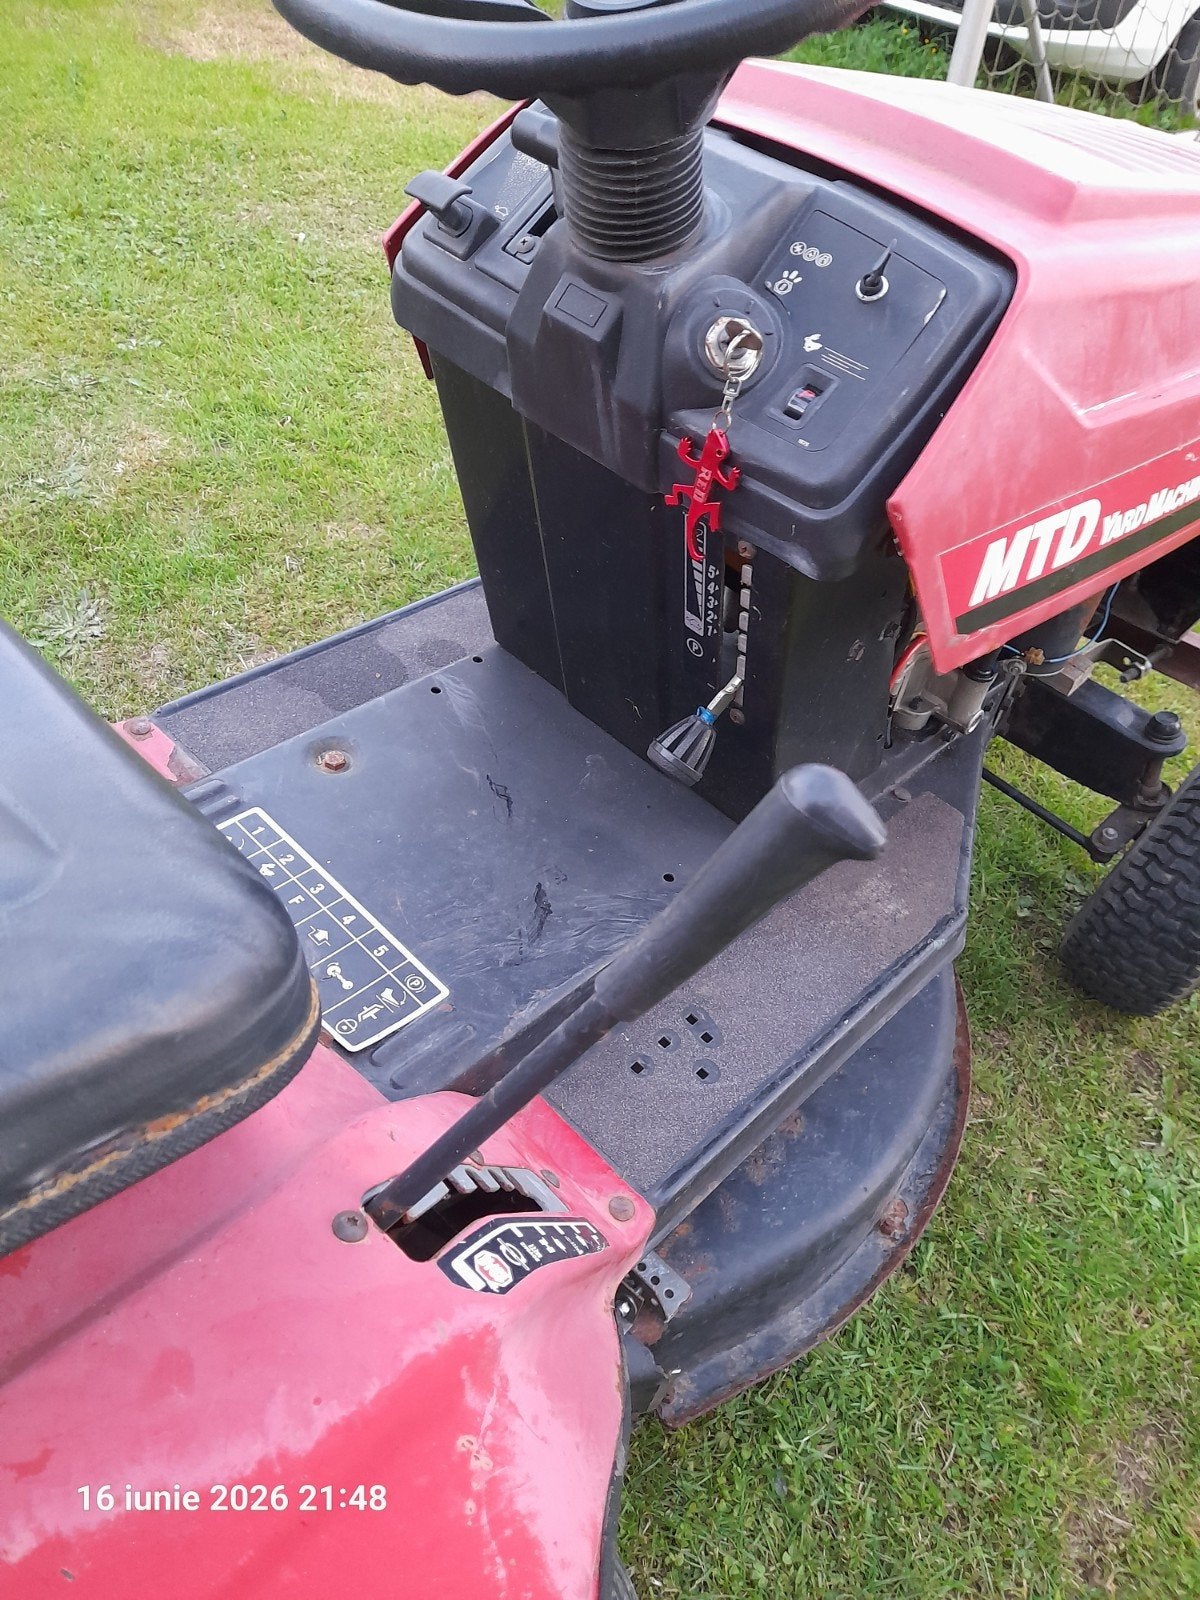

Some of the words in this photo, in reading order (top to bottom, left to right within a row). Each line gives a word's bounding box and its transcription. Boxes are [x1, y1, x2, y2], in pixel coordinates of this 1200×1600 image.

[693, 466, 713, 503] RED
[968, 498, 1102, 607] MTD
[707, 564, 716, 579] 5
[706, 581, 716, 595] 4
[706, 596, 715, 609] 3
[705, 610, 714, 624] 2
[706, 625, 713, 637] 1
[251, 826, 265, 836] 1
[279, 854, 295, 866] 2
[309, 883, 325, 894] 3
[288, 894, 305, 904] F
[341, 914, 356, 925] 4
[373, 944, 389, 957] 5
